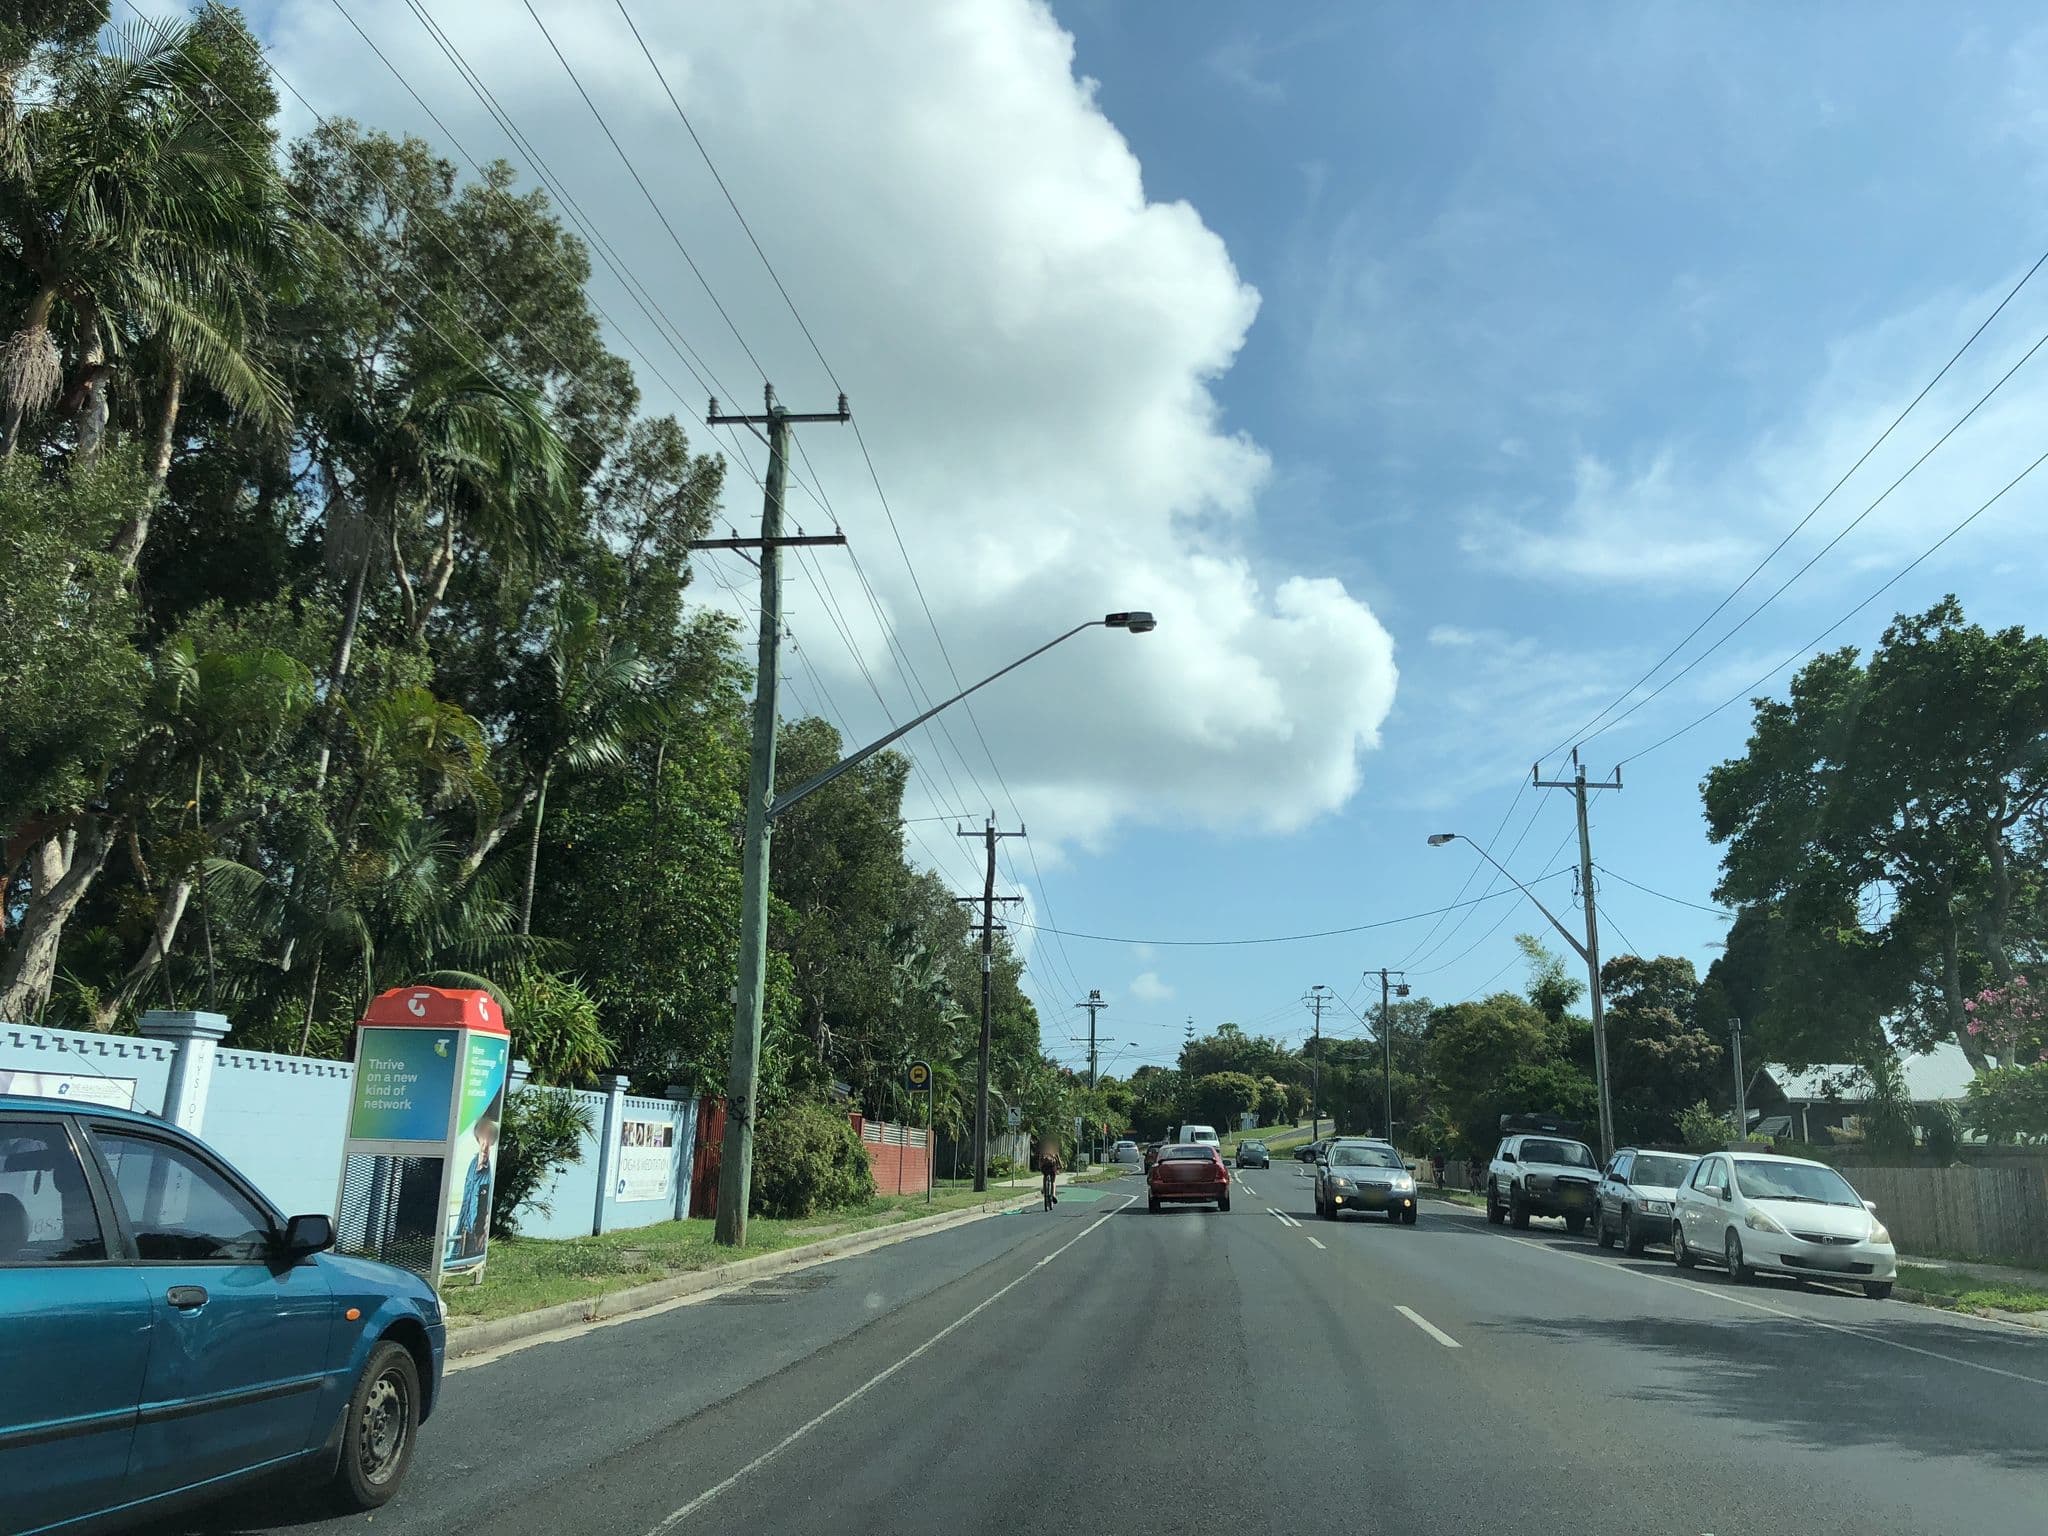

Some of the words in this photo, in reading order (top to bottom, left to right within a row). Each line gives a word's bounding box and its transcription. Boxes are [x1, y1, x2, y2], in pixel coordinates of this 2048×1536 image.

[368, 1058, 405, 1070] Thrive
[367, 1072, 381, 1082] on
[383, 1073, 393, 1082] a
[394, 1073, 418, 1083] new
[365, 1085, 391, 1096] kind
[393, 1085, 407, 1096] of
[363, 1099, 412, 1110] network
